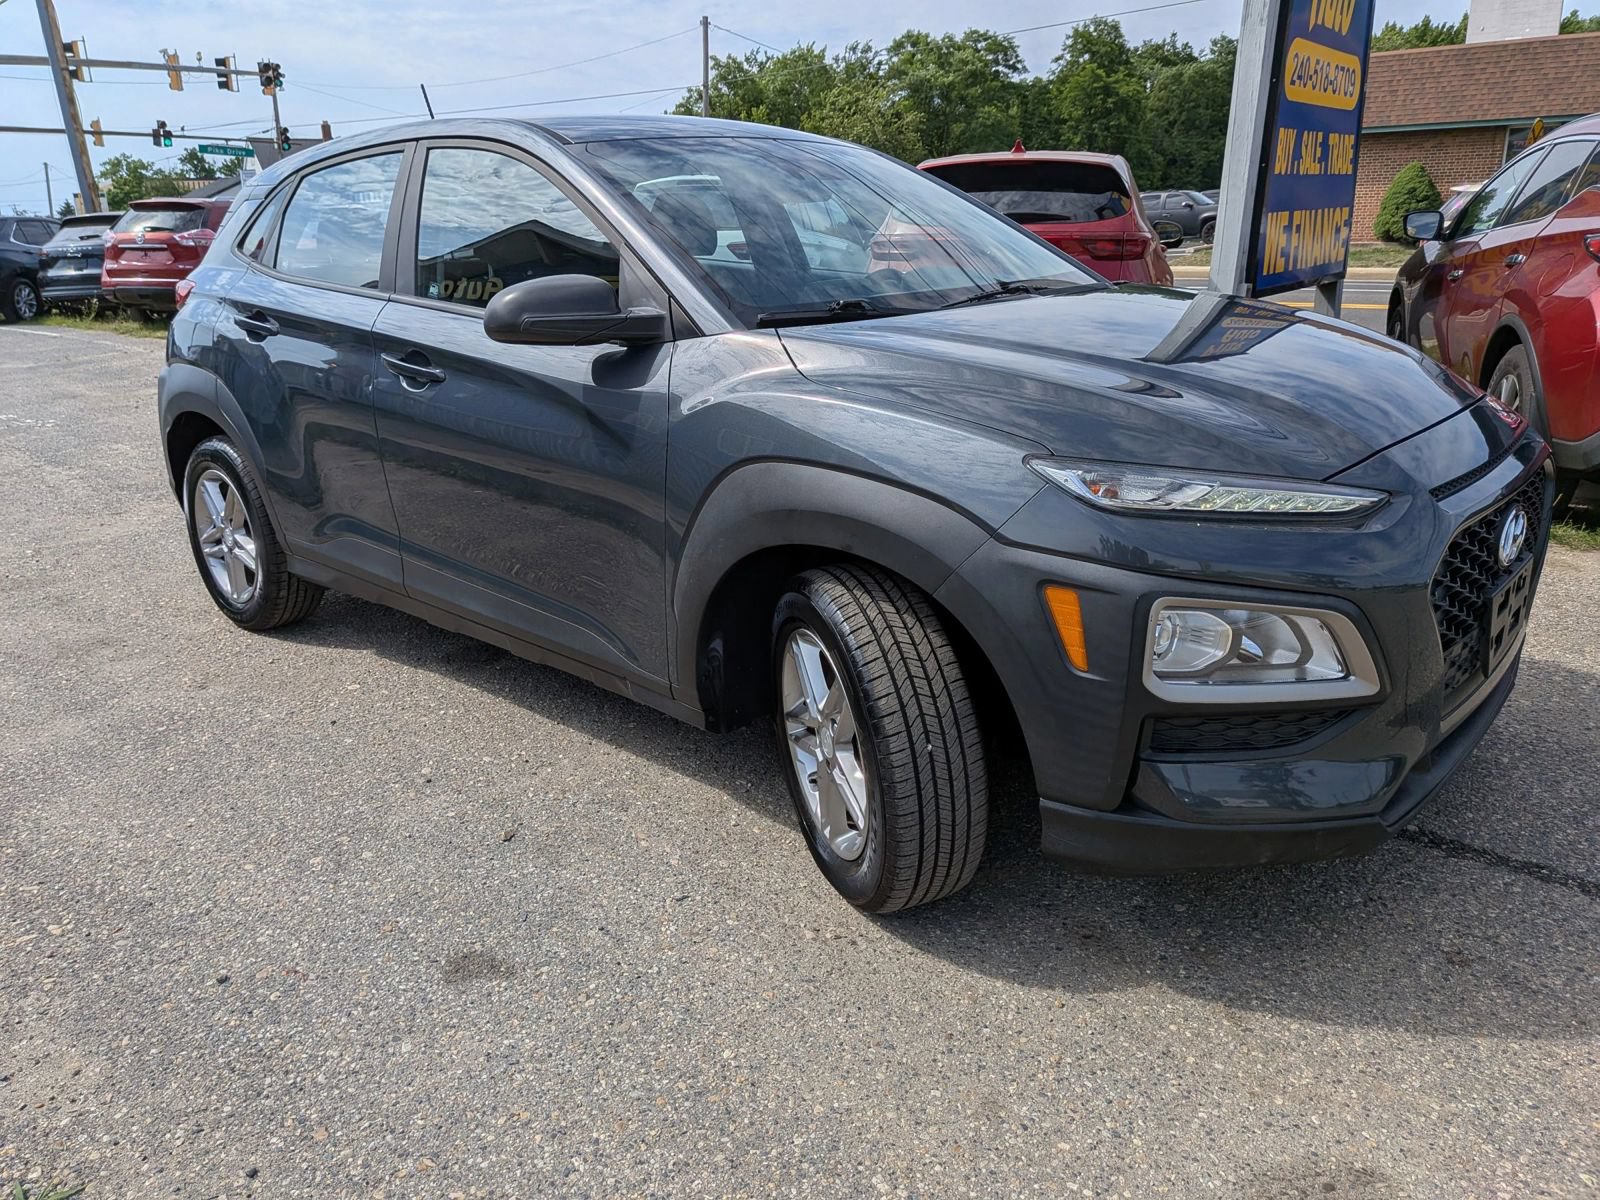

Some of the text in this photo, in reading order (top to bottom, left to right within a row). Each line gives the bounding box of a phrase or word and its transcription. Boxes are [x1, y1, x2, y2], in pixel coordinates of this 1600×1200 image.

[1289, 51, 1356, 98] 240-518-8709
[1327, 132, 1355, 175] TRADE
[1263, 206, 1350, 276] WE FINANCE
